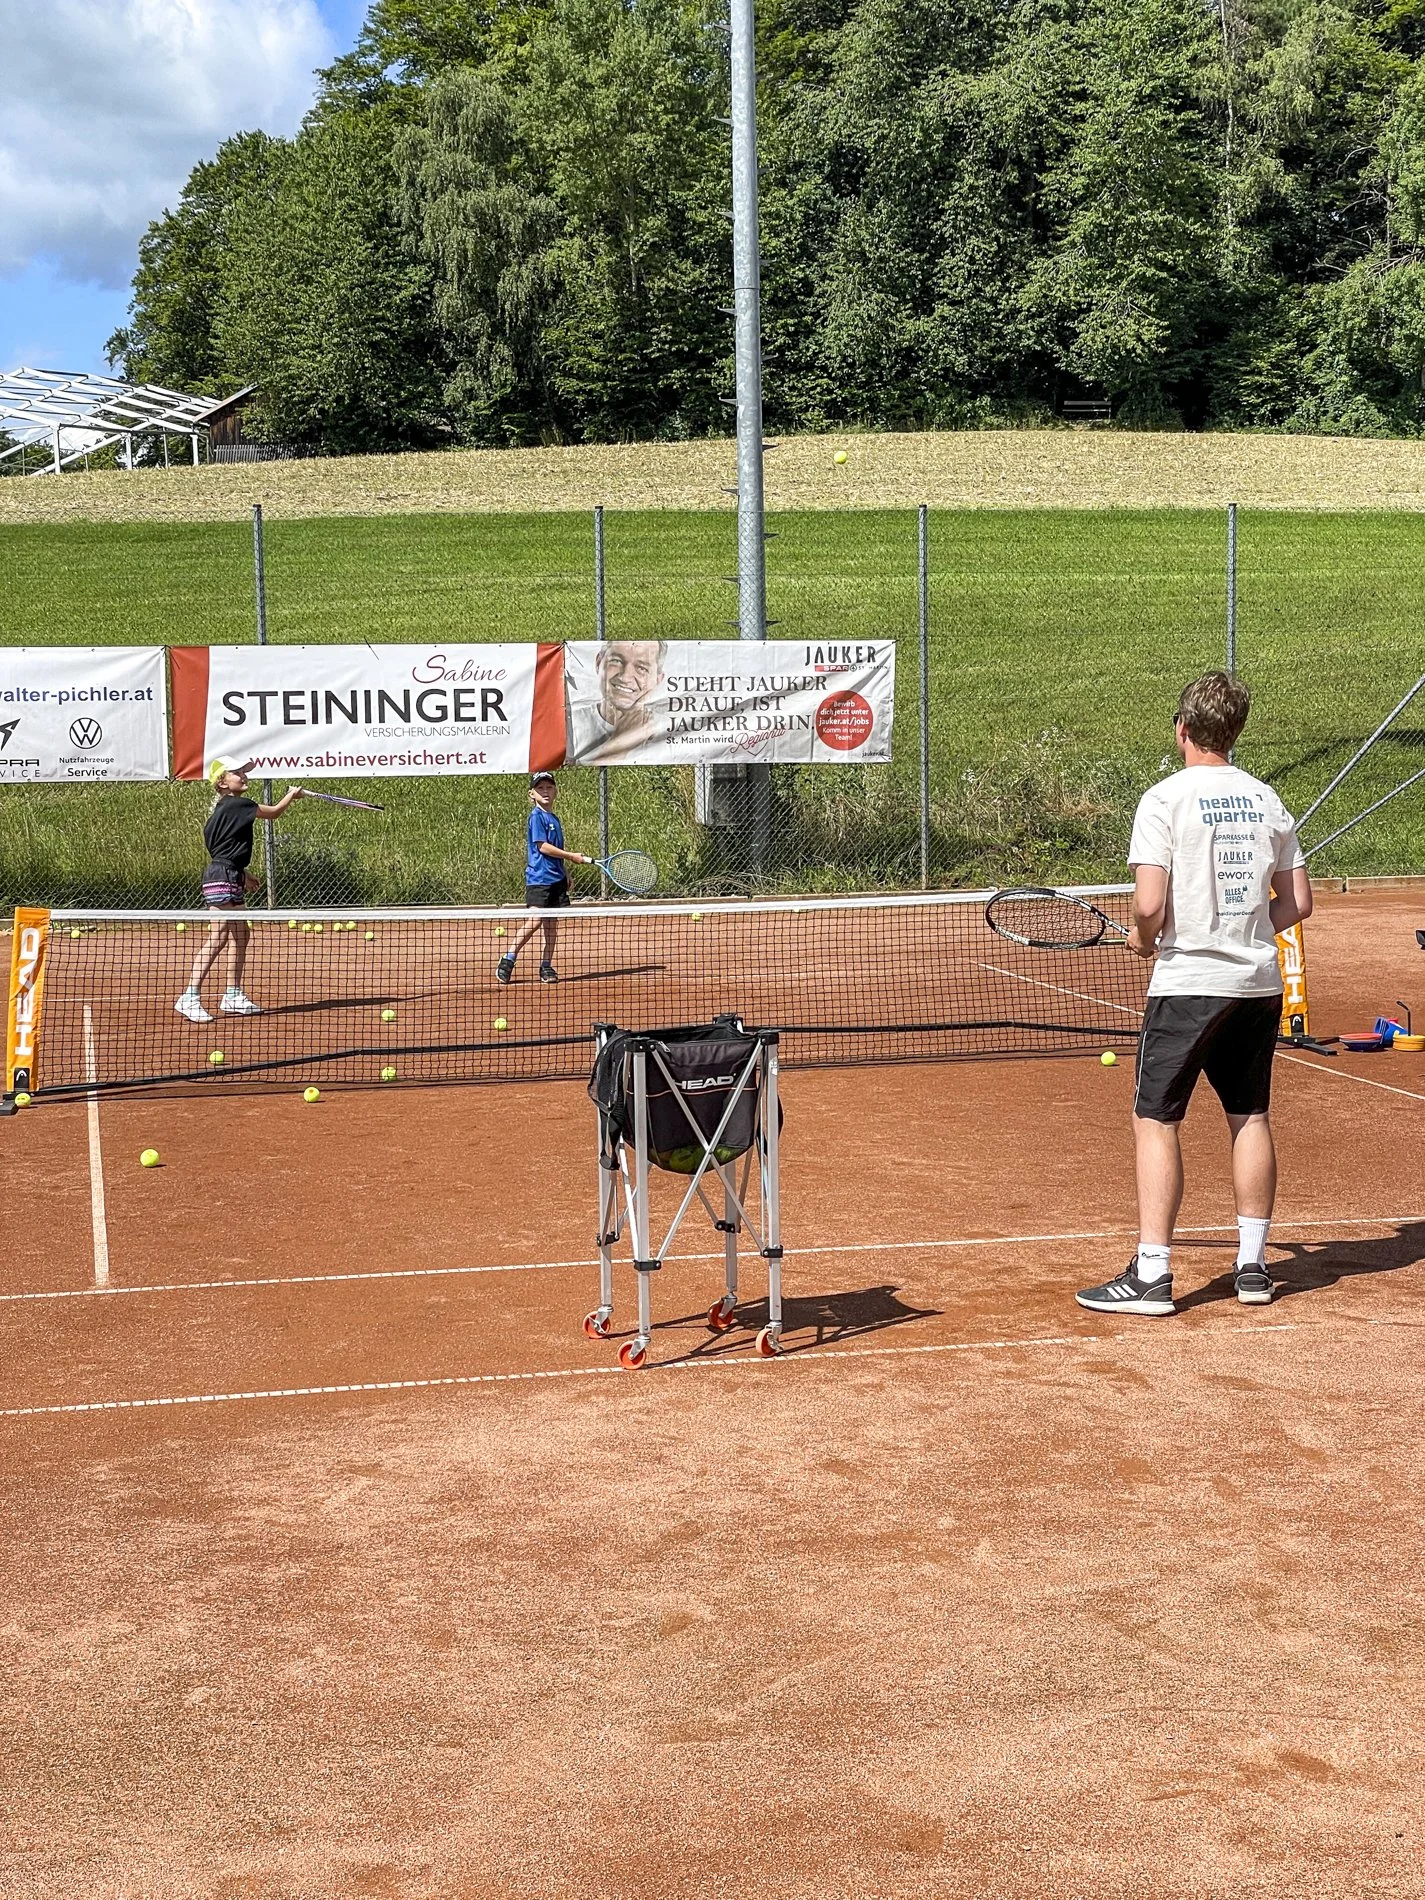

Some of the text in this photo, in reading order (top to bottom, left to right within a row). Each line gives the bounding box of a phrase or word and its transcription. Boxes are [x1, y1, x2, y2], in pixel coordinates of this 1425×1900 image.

[805, 646, 876, 666] JAUKER
[412, 654, 507, 683] Sabine
[667, 675, 828, 692] STEHT JAUKER
[0, 686, 153, 705] alter-pichler.at
[222, 688, 508, 726] STEININGER
[668, 695, 786, 713] DRAUF, IST
[834, 708, 850, 716] jetzt
[666, 714, 815, 733] JAUKER DRIN.
[818, 717, 870, 727] jauker.at/jobs
[365, 725, 511, 737] VERSICHERUNGSMAKLERIN
[666, 736, 679, 745] St.
[681, 735, 710, 744] Martin
[713, 734, 734, 743] wird
[59, 756, 115, 764] Nutzfahrzeuge
[250, 750, 487, 768] www.sabineversichert.at
[67, 767, 108, 777] Service
[1199, 796, 1254, 811] health
[1202, 809, 1265, 826] quarter
[1213, 833, 1249, 841] SPARKASSE
[1218, 851, 1254, 862] JAUKER
[1217, 871, 1254, 880] eworx
[1282, 926, 1304, 1004] HEA
[15, 927, 40, 1056] HEAD
[673, 1075, 735, 1090] HEAD
